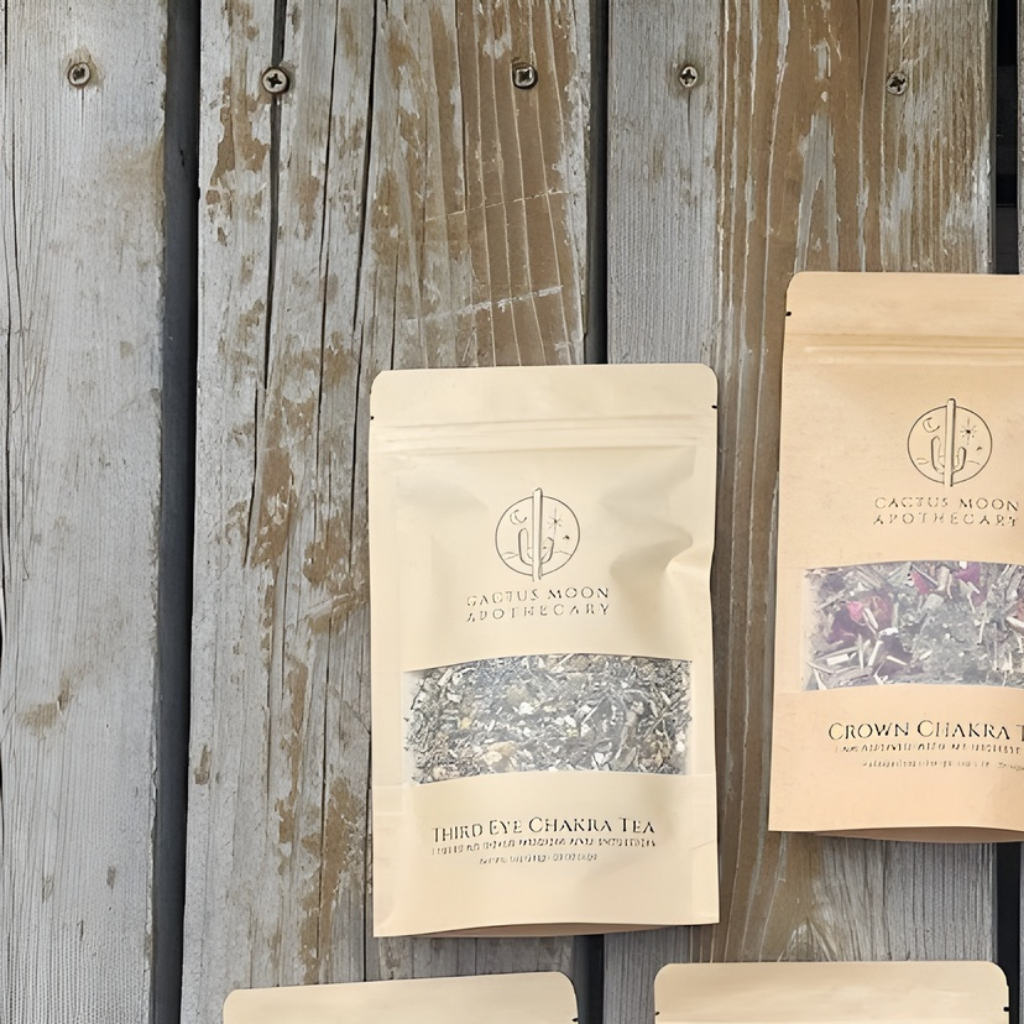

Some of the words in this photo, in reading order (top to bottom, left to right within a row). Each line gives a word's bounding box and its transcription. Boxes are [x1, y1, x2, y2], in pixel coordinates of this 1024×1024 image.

[875, 497, 948, 508] CACTUS
[959, 497, 1018, 511] MOON
[467, 589, 539, 606] CACTUS
[548, 586, 608, 599] MOON
[828, 722, 909, 740] CROWN
[917, 720, 1010, 740] CHAKRA
[432, 823, 482, 842] THIRD
[490, 819, 522, 835] EYE
[529, 817, 611, 833] CHAKRA
[619, 817, 655, 834] TEA
